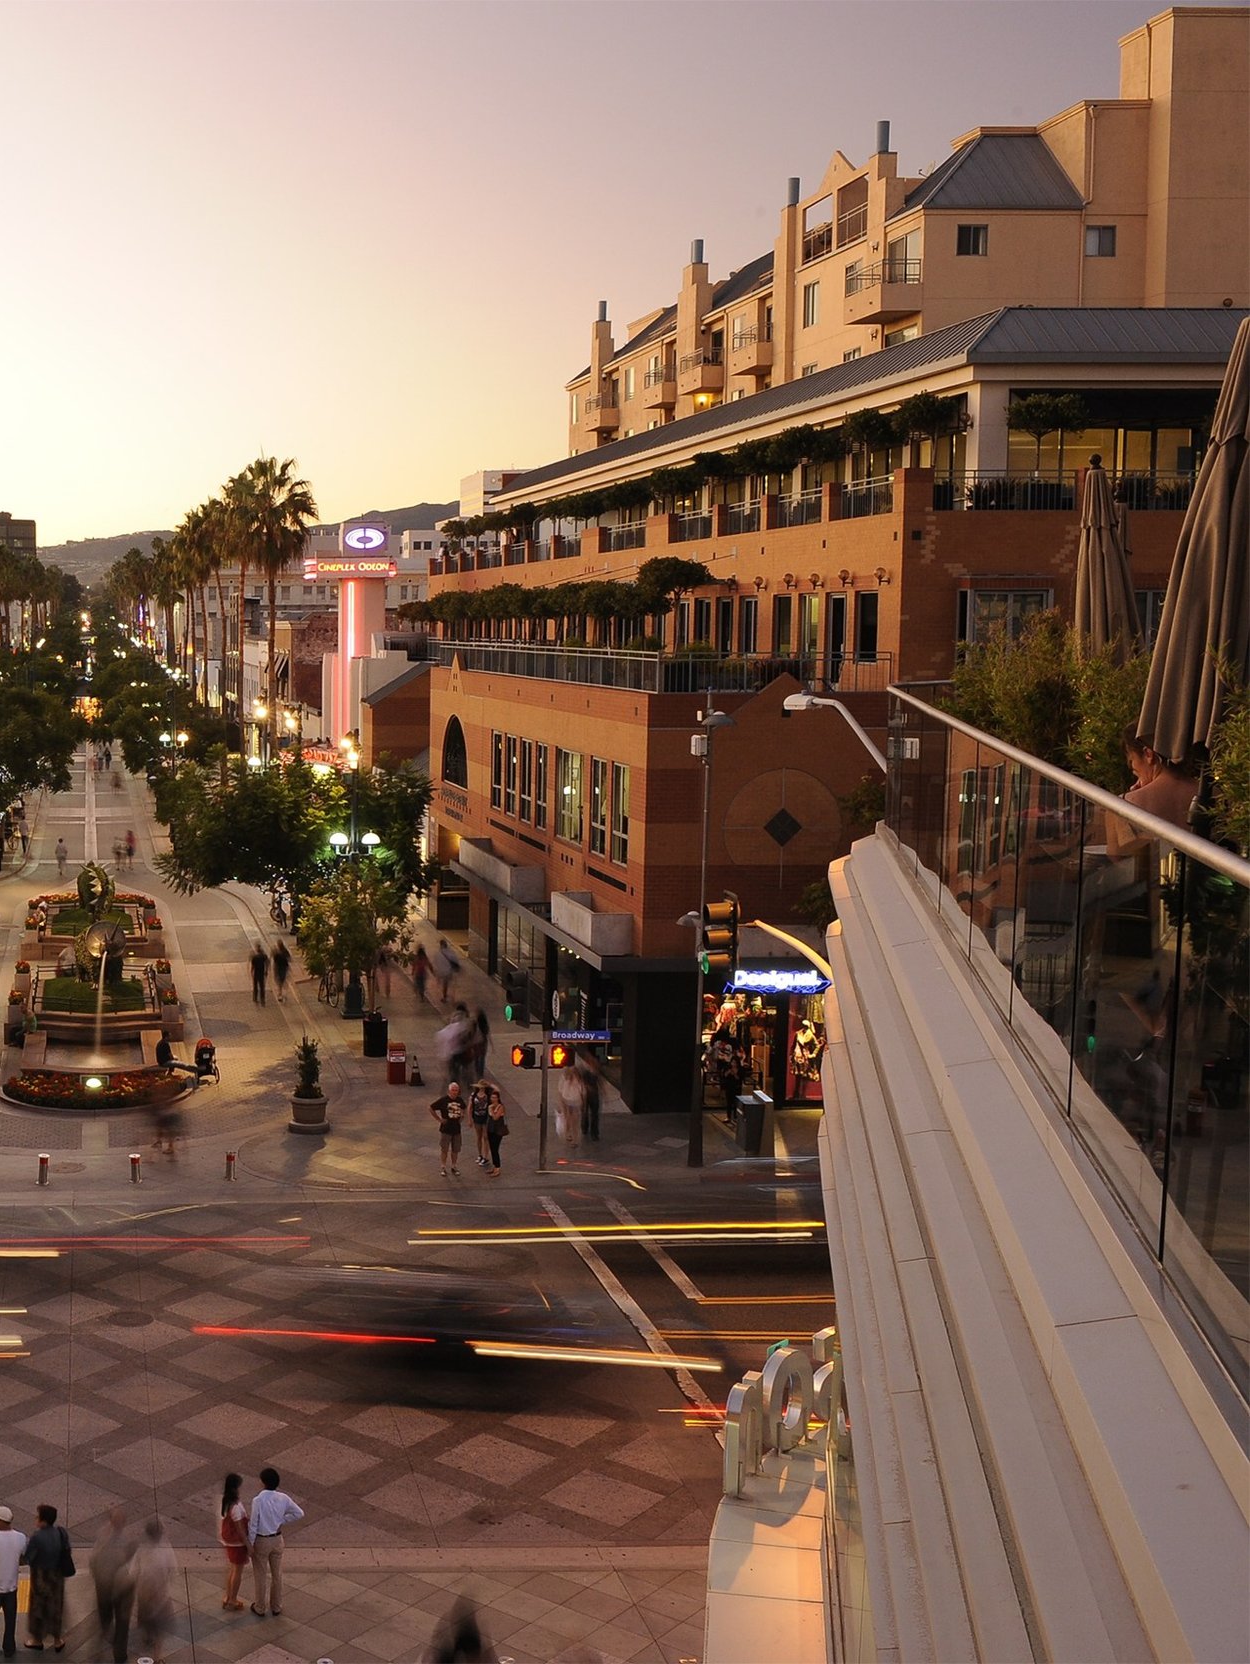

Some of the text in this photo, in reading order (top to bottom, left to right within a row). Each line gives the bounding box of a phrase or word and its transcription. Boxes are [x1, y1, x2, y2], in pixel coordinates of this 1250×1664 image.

[317, 562, 389, 571] CINEPLEX ODEON
[552, 1031, 595, 1040] Broadway
